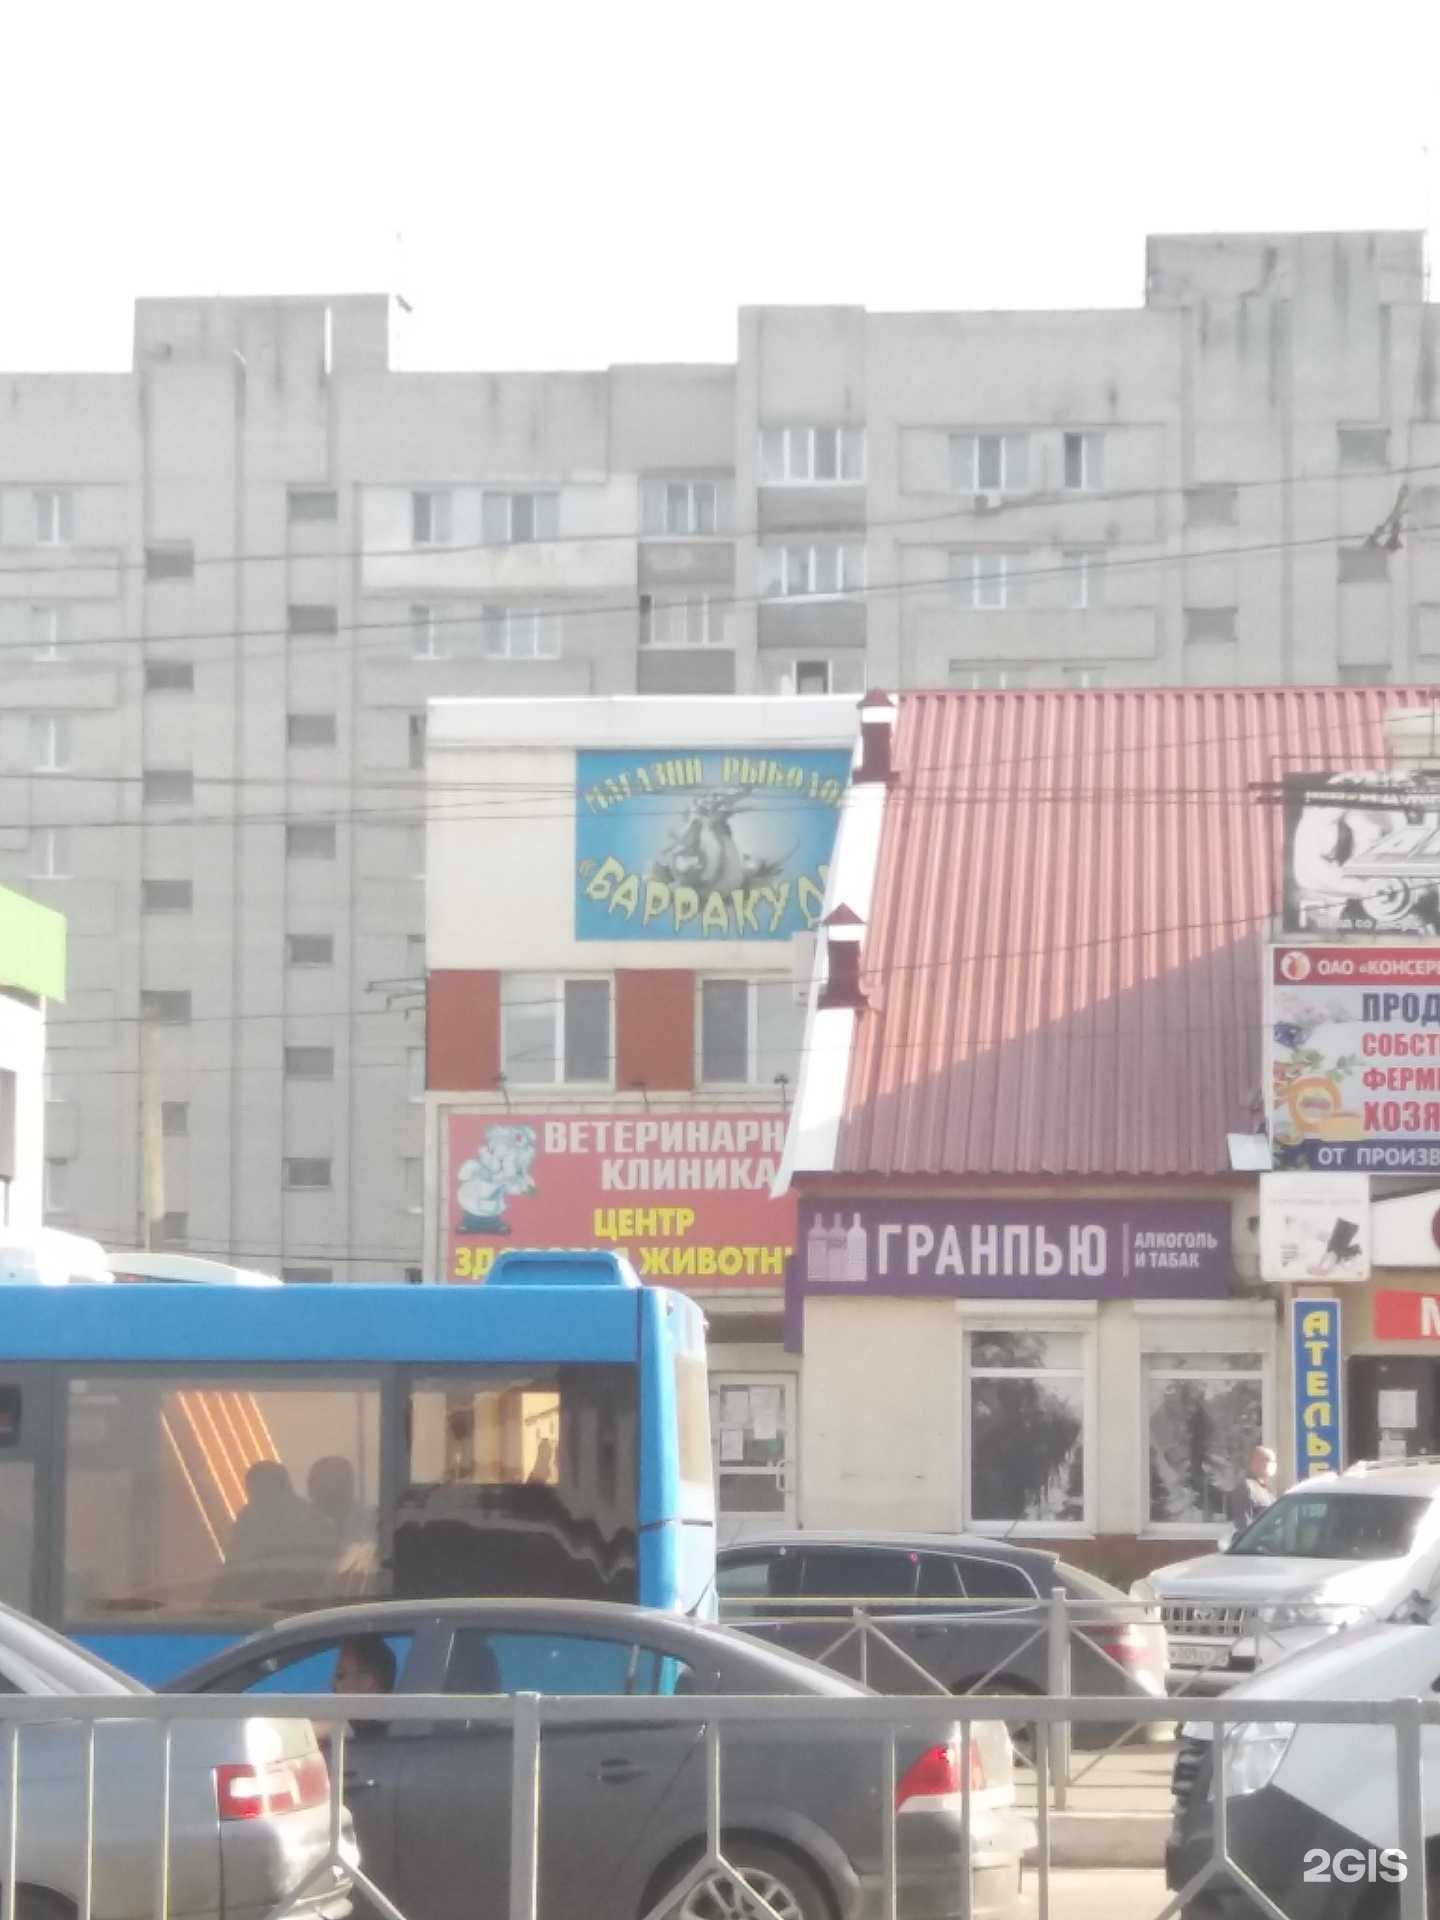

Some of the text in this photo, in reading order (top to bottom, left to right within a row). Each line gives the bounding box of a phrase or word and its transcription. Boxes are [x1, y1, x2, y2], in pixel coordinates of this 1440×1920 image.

[1317, 960, 1353, 975] ОАО
[1362, 1067, 1440, 1091] ФЕРМ
[1318, 1147, 1344, 1164] ОТ
[602, 1158, 778, 1191] КЛИНИКА
[594, 1208, 695, 1240] ЦЕНТР
[878, 1224, 1107, 1277] ГРАНПЬЮ
[1134, 1231, 1219, 1249] АЛКОГОЛЬ
[640, 1249, 793, 1276] ЖИВОТН
[1134, 1252, 1200, 1269] И ТАБАК
